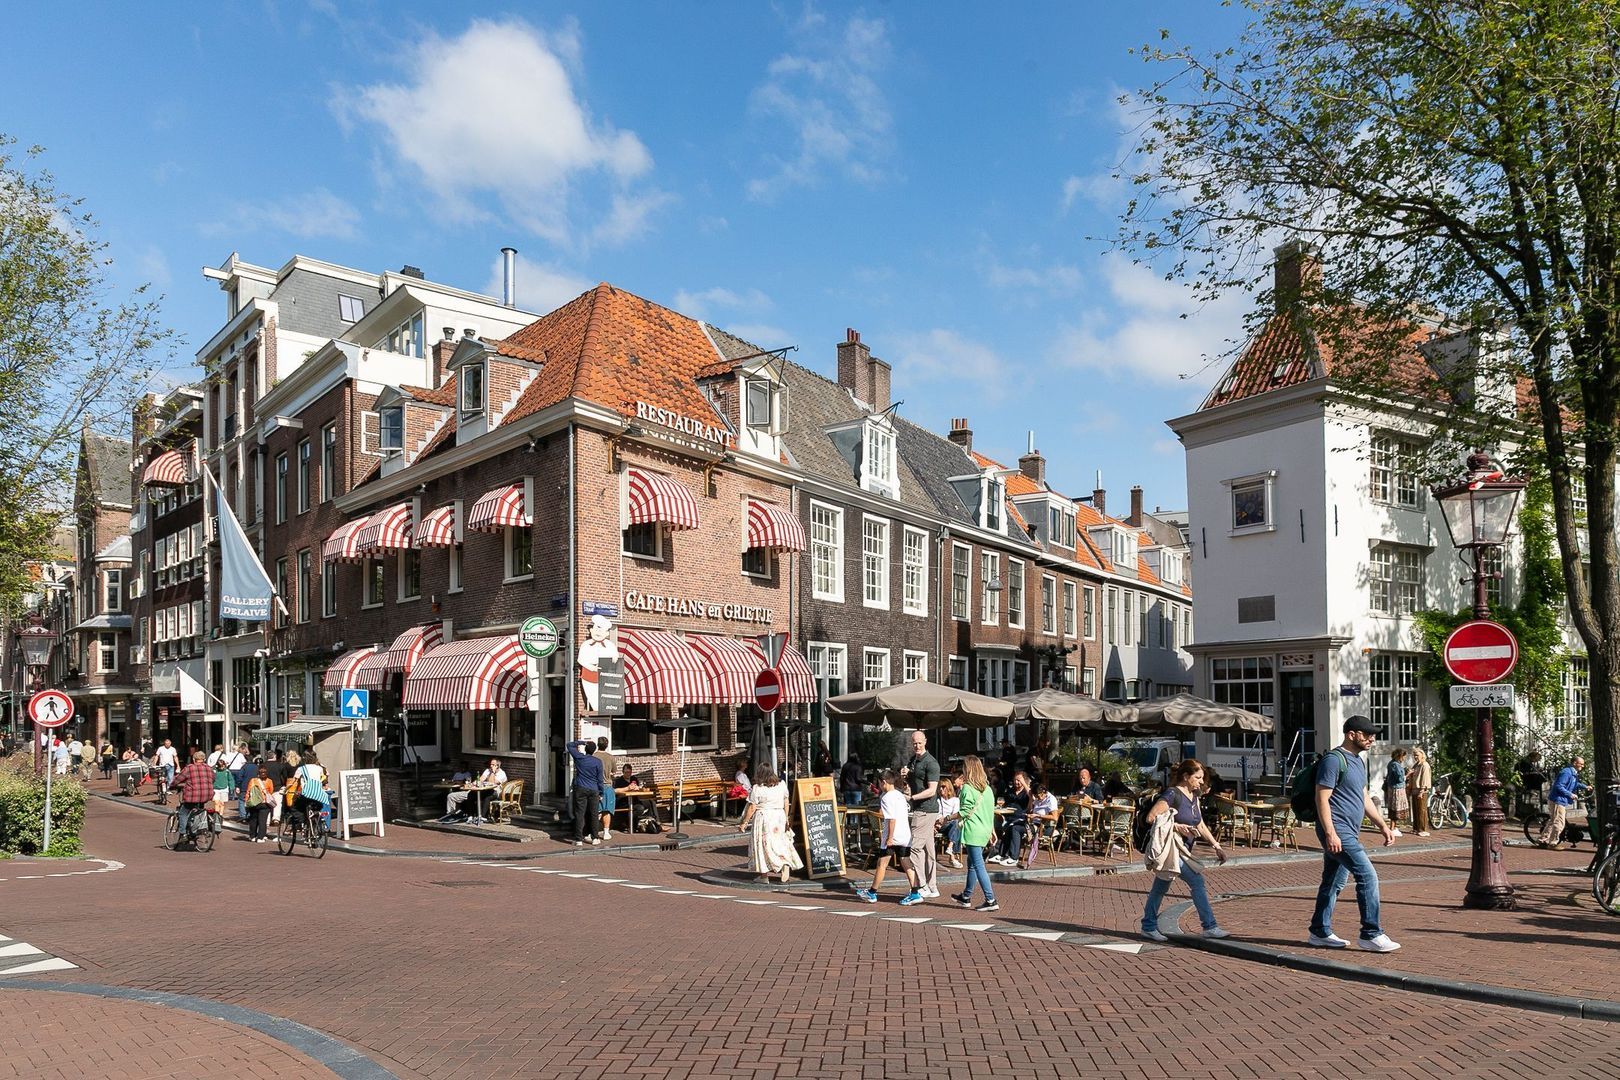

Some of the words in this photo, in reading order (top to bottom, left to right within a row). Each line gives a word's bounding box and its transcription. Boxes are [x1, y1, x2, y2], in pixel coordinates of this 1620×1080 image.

[636, 400, 733, 447] RESTAURANT
[222, 595, 270, 606] GALLERY
[223, 606, 268, 617] DELAIVE
[667, 597, 704, 616] HANS
[707, 605, 720, 618] en
[723, 604, 773, 623] GRIETJE
[525, 633, 555, 641] Heineken
